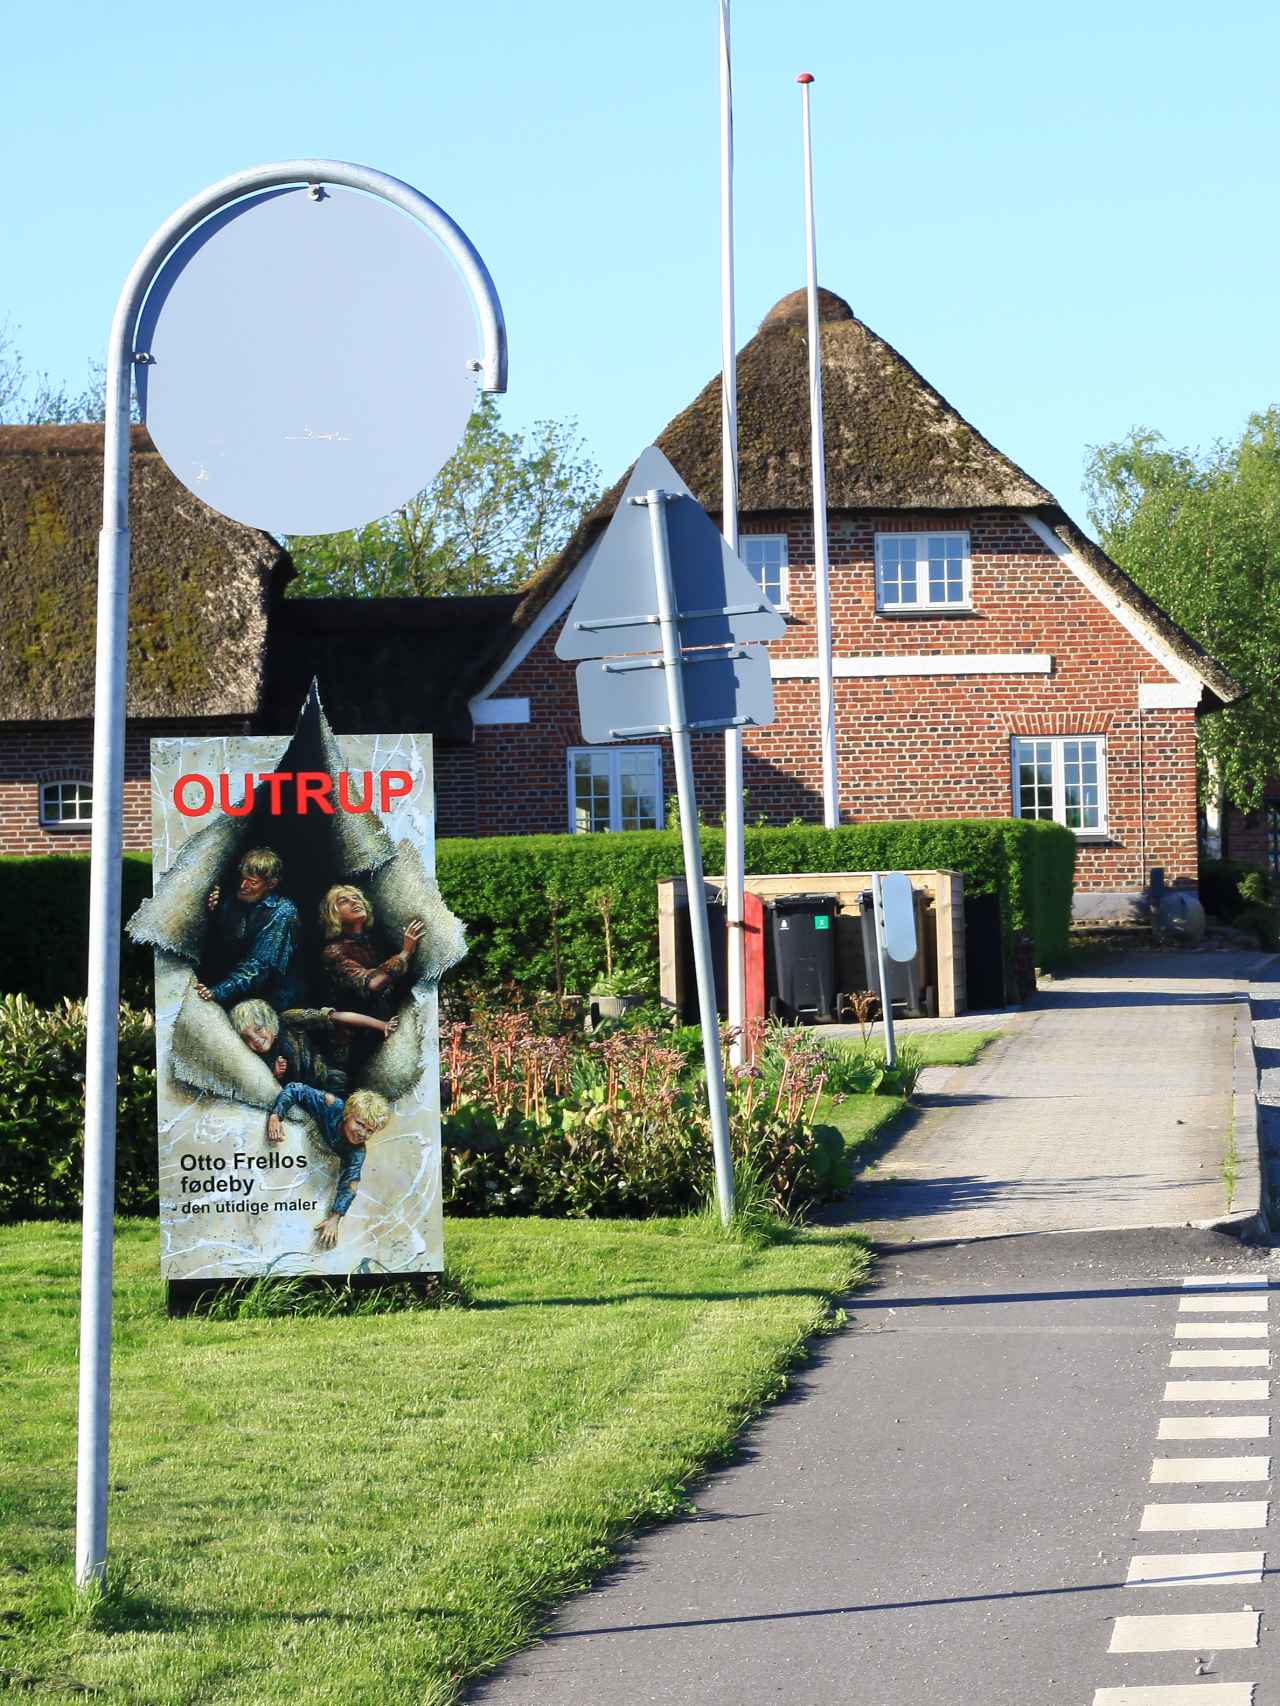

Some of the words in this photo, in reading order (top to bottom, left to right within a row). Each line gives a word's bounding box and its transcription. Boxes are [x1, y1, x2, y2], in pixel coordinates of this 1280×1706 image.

[173, 770, 414, 817] OUTRUP
[180, 1153, 226, 1171] Otto
[233, 1151, 308, 1169] Frellos
[180, 1175, 254, 1196] fødeby
[181, 1201, 210, 1214] den
[216, 1199, 269, 1215] utidige
[274, 1198, 318, 1211] maler
